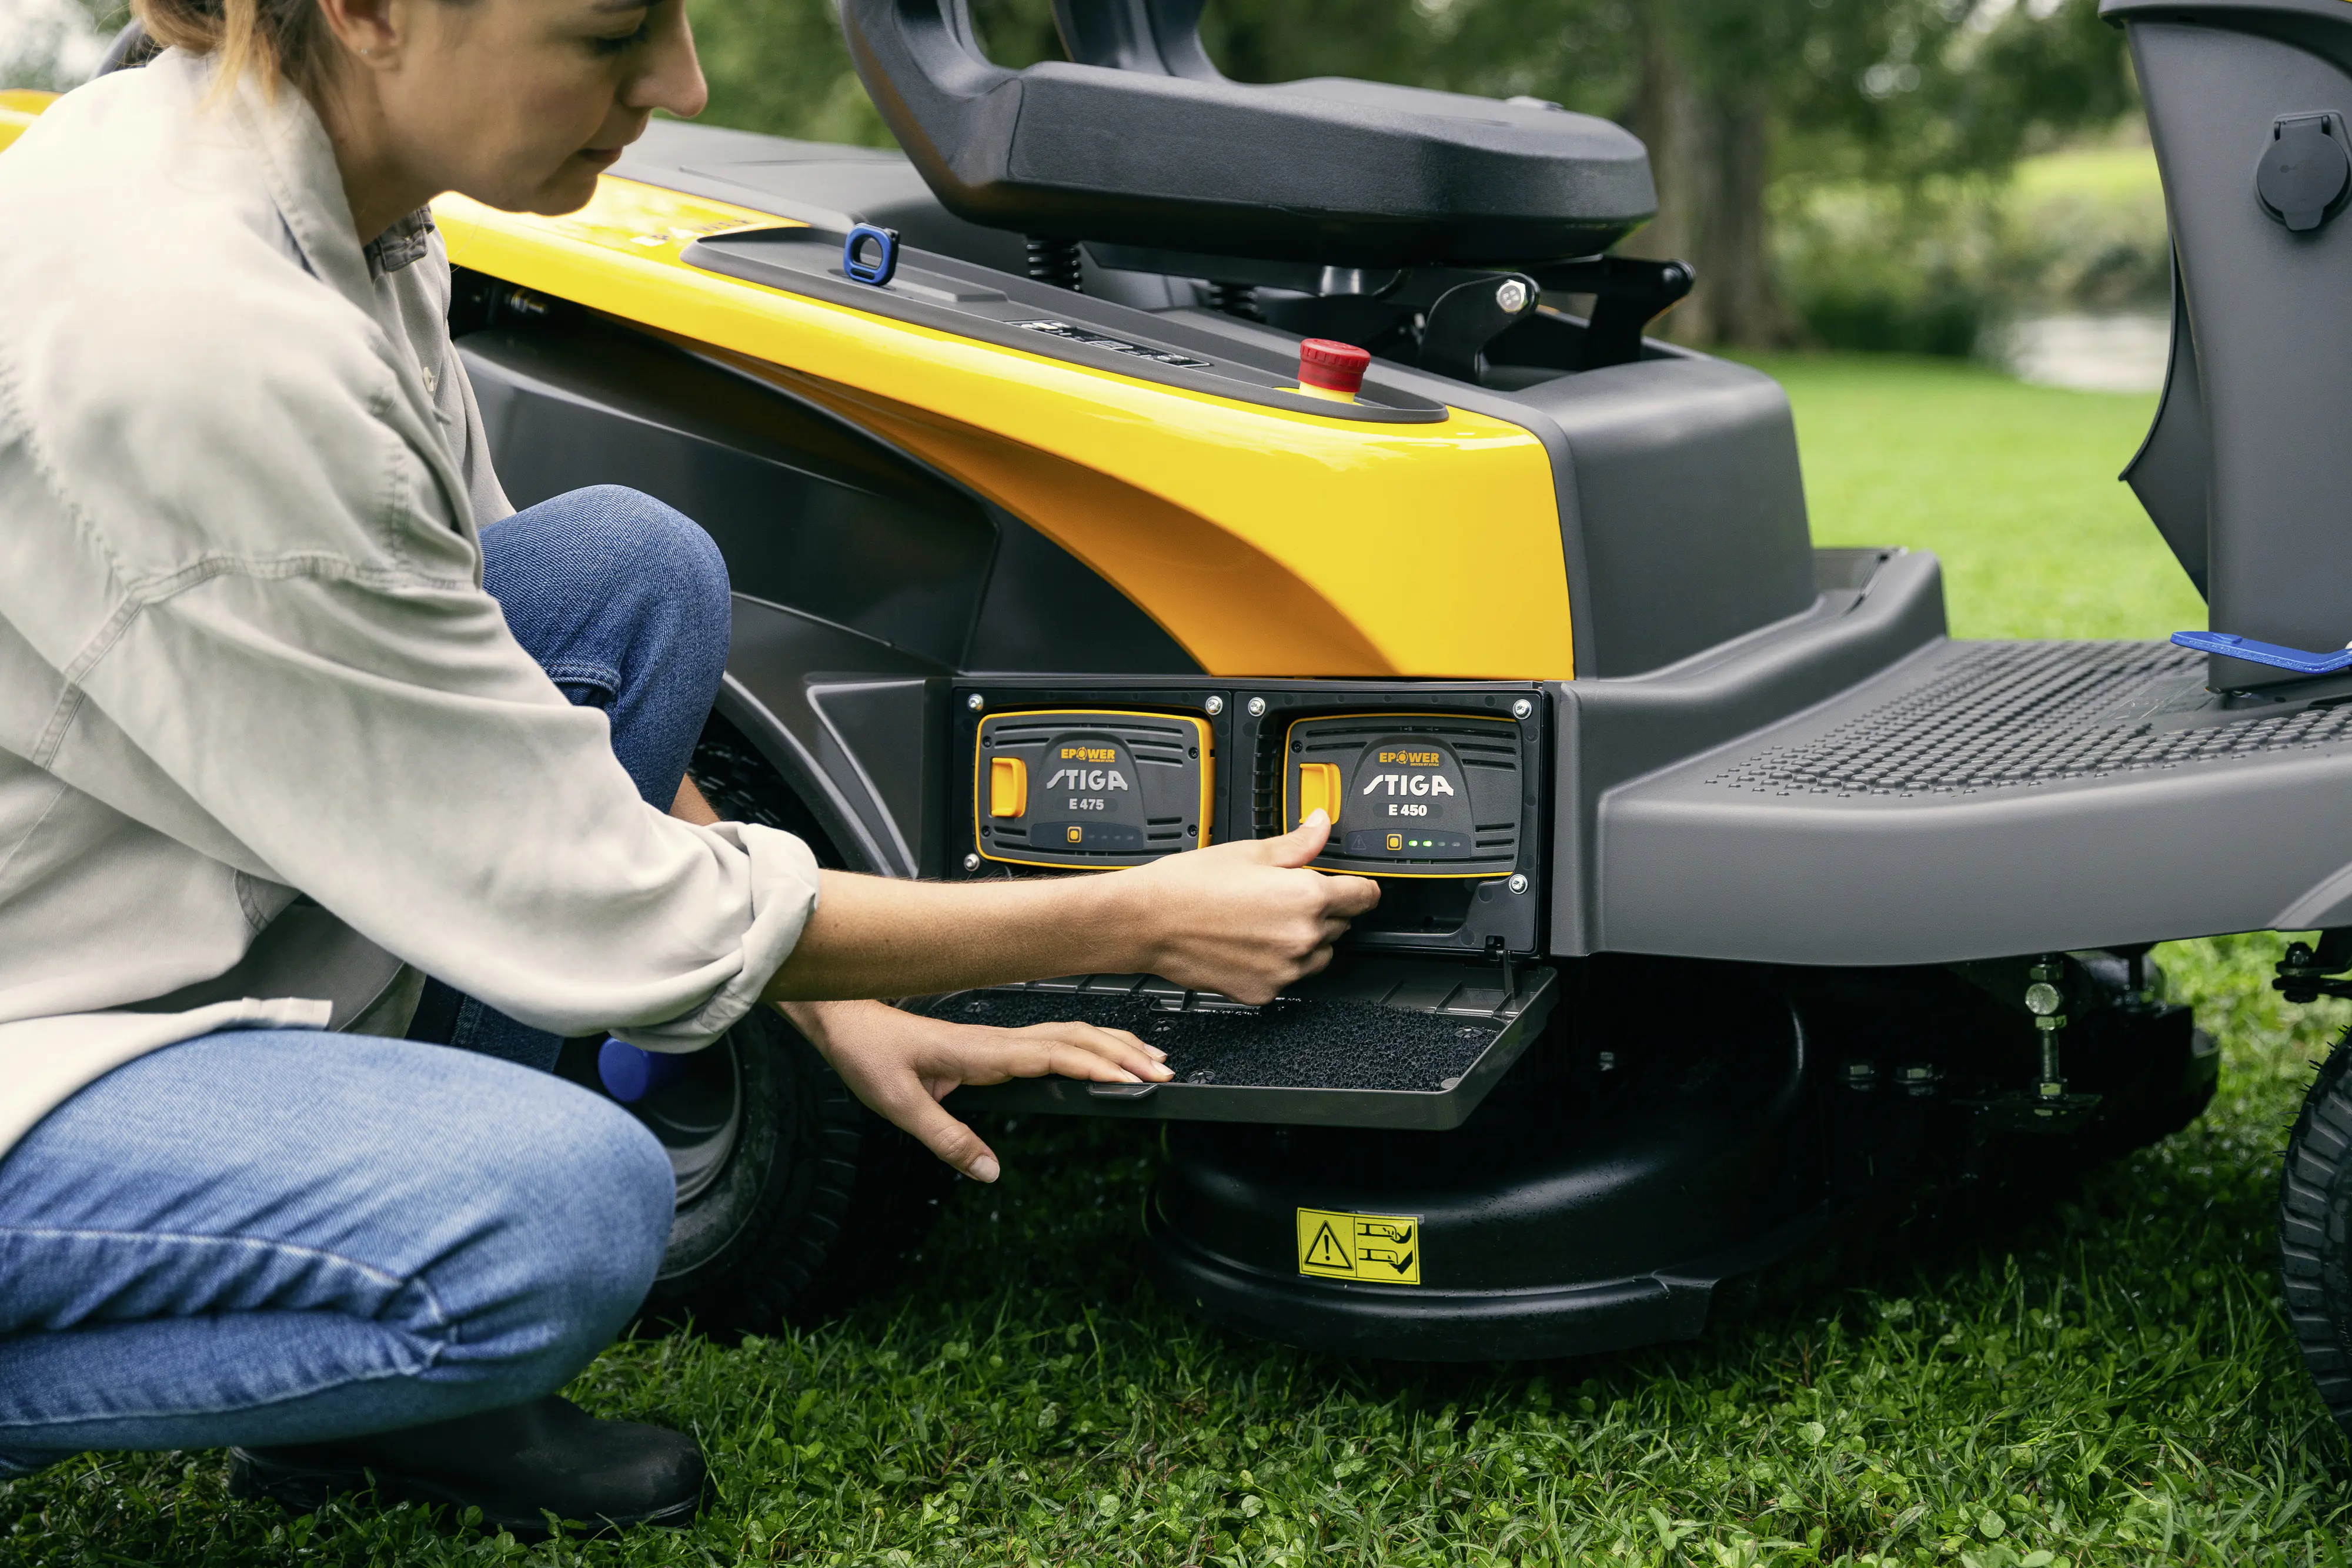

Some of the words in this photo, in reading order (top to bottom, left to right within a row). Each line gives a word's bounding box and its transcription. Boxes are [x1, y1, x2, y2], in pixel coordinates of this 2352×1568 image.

[1061, 746, 1115, 760] EPOWER
[1379, 750, 1439, 764] EPOWER
[1046, 769, 1128, 791] STIGA
[1363, 774, 1454, 797] STIGA
[1069, 798, 1078, 810] E
[1080, 798, 1104, 810] 475
[1388, 804, 1398, 816] E
[1400, 804, 1428, 817] 450
